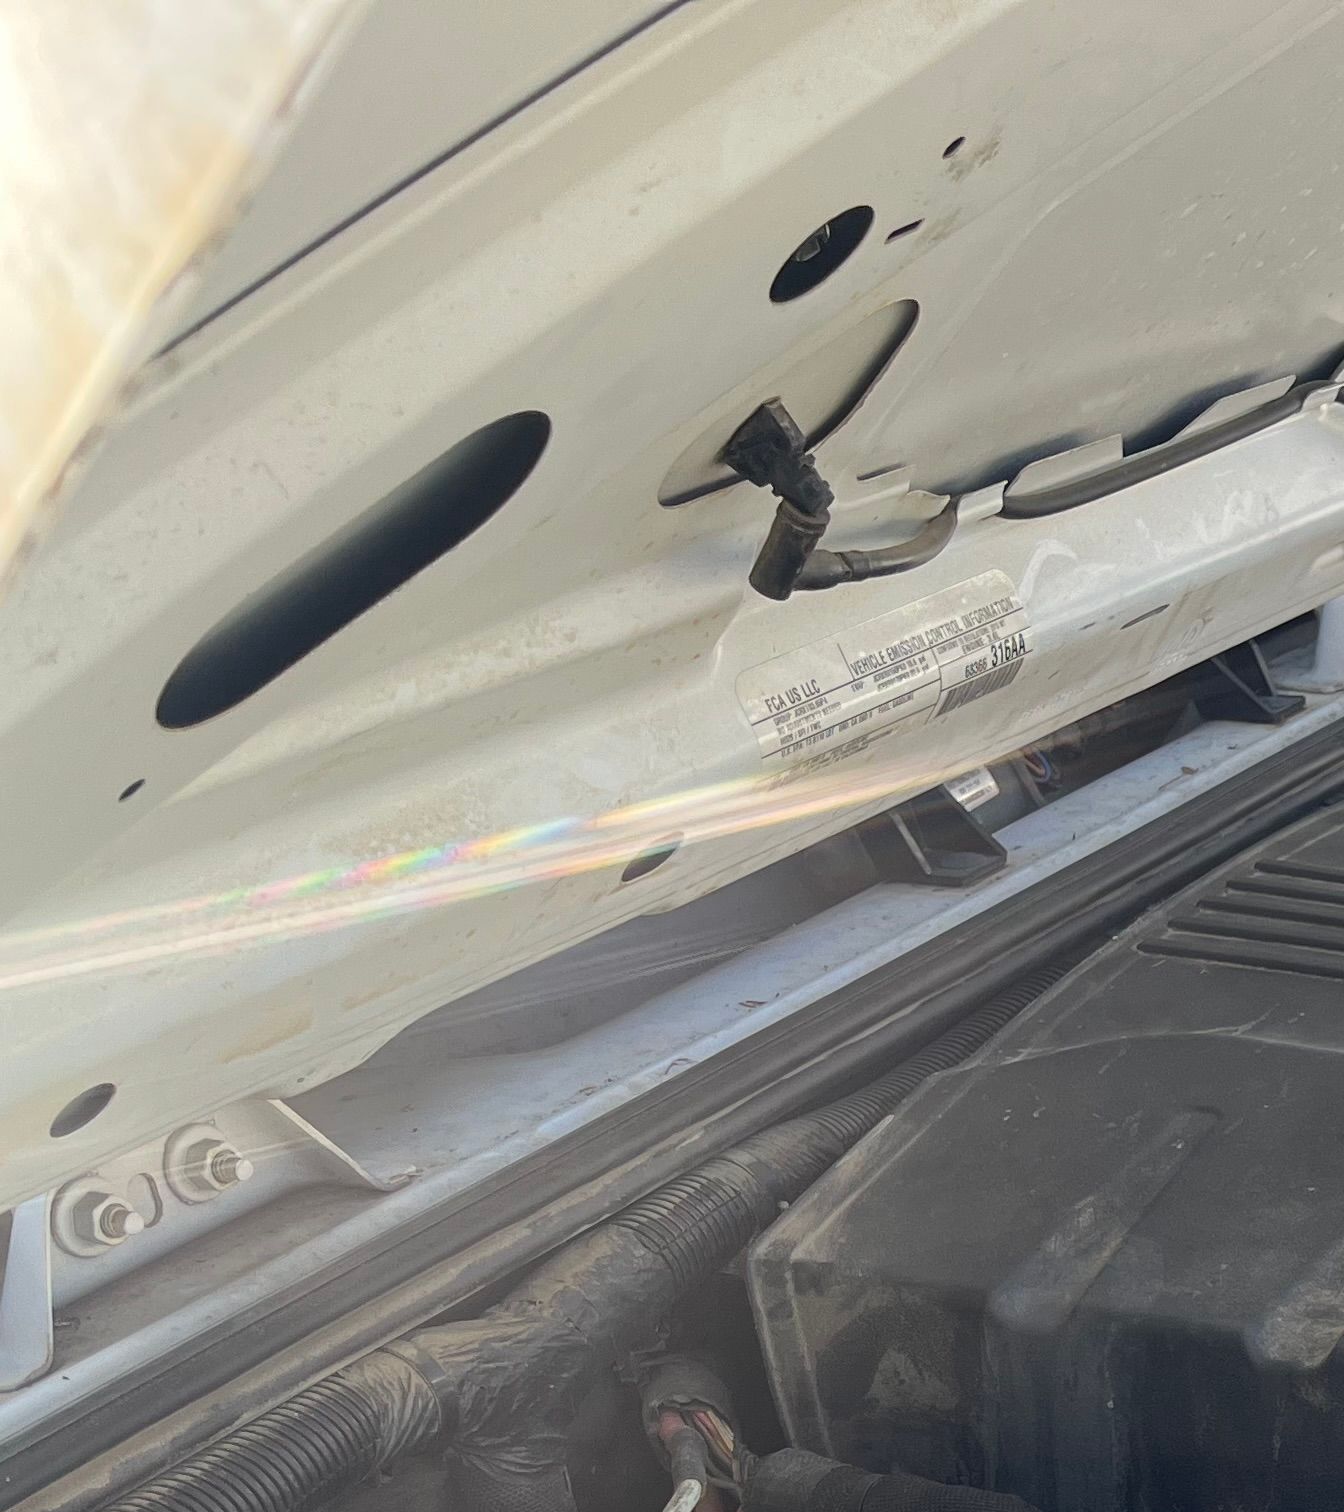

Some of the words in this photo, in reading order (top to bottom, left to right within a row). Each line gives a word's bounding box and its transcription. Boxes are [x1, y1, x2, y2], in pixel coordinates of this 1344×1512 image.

[849, 649, 887, 676] VEHICLE
[885, 632, 927, 661] EMISSION
[924, 617, 963, 645] CONTROL
[960, 596, 1015, 630] INFORMATION
[991, 632, 1024, 667] 316AA
[764, 691, 787, 713] FCA
[784, 685, 802, 705] US
[800, 678, 821, 698] LLC
